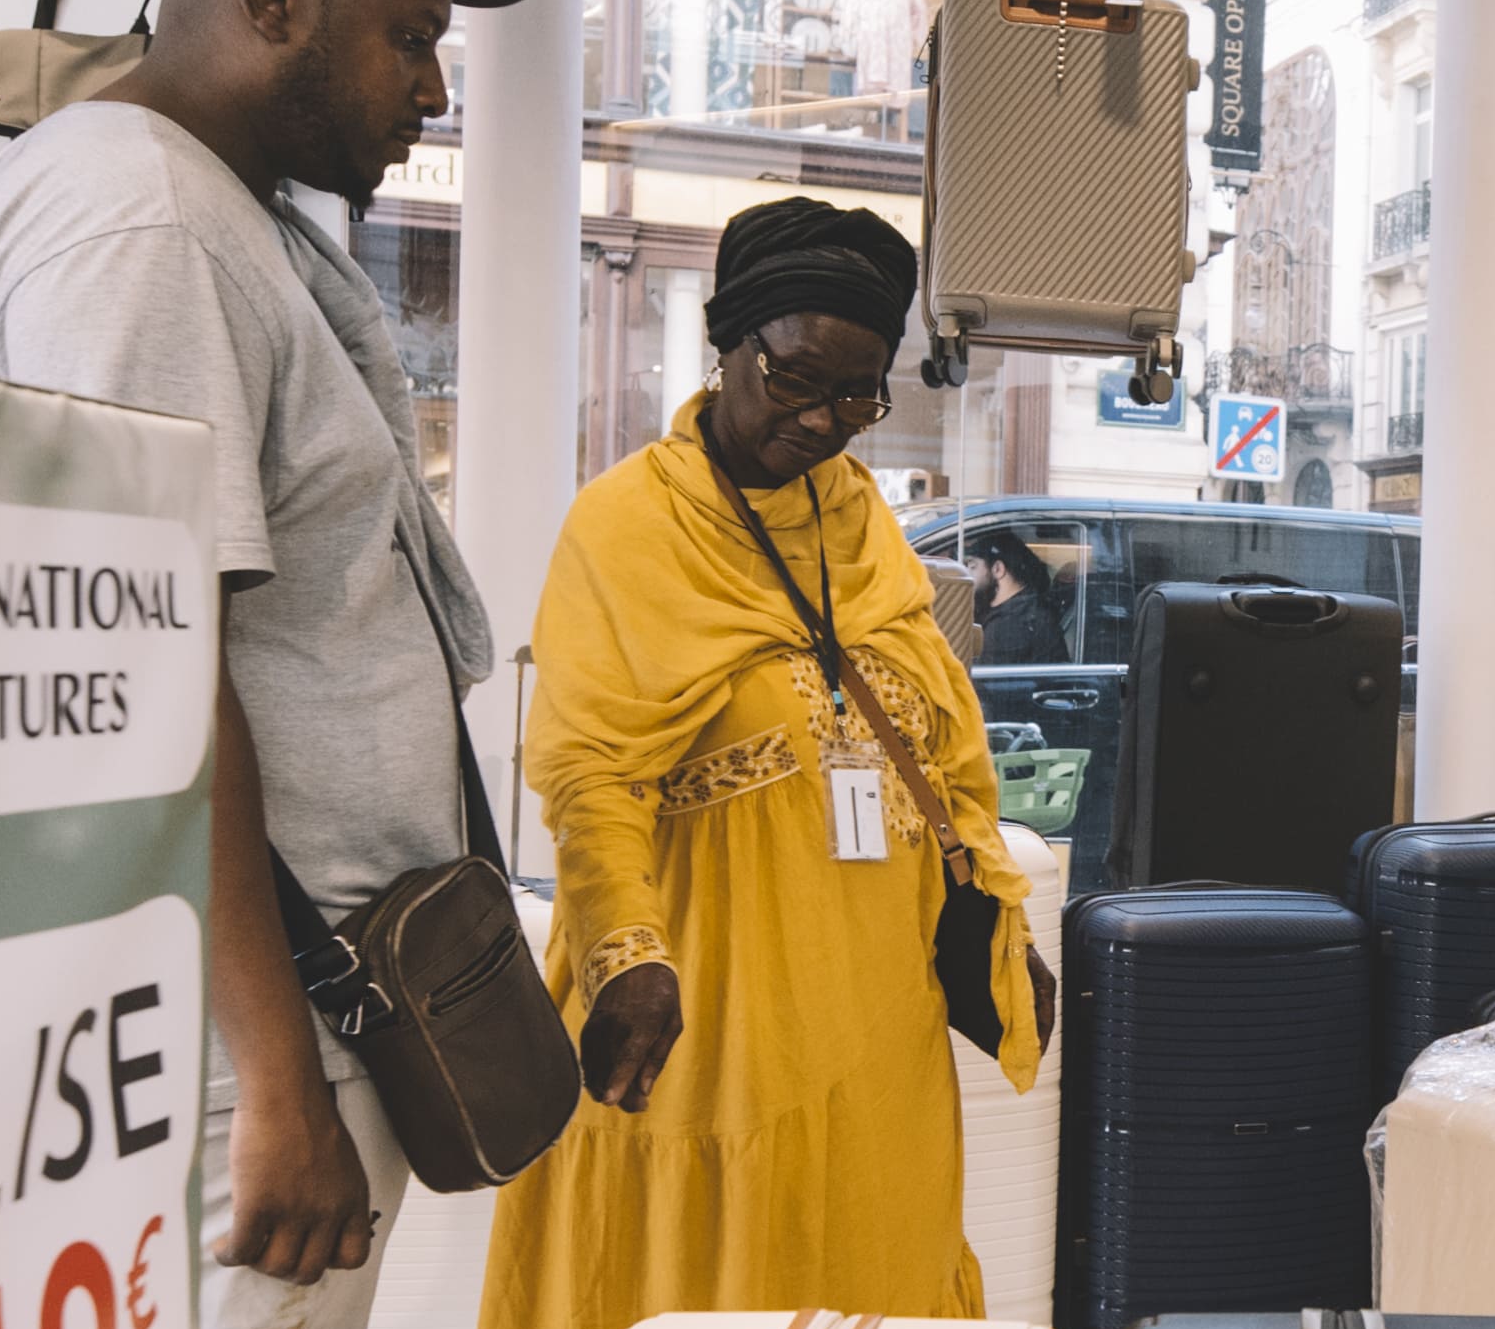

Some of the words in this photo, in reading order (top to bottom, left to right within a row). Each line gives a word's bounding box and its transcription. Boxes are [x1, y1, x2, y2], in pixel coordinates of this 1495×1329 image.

[1221, 39, 1244, 137] SQUARE
[390, 154, 454, 186] ard
[1258, 454, 1272, 466] 20
